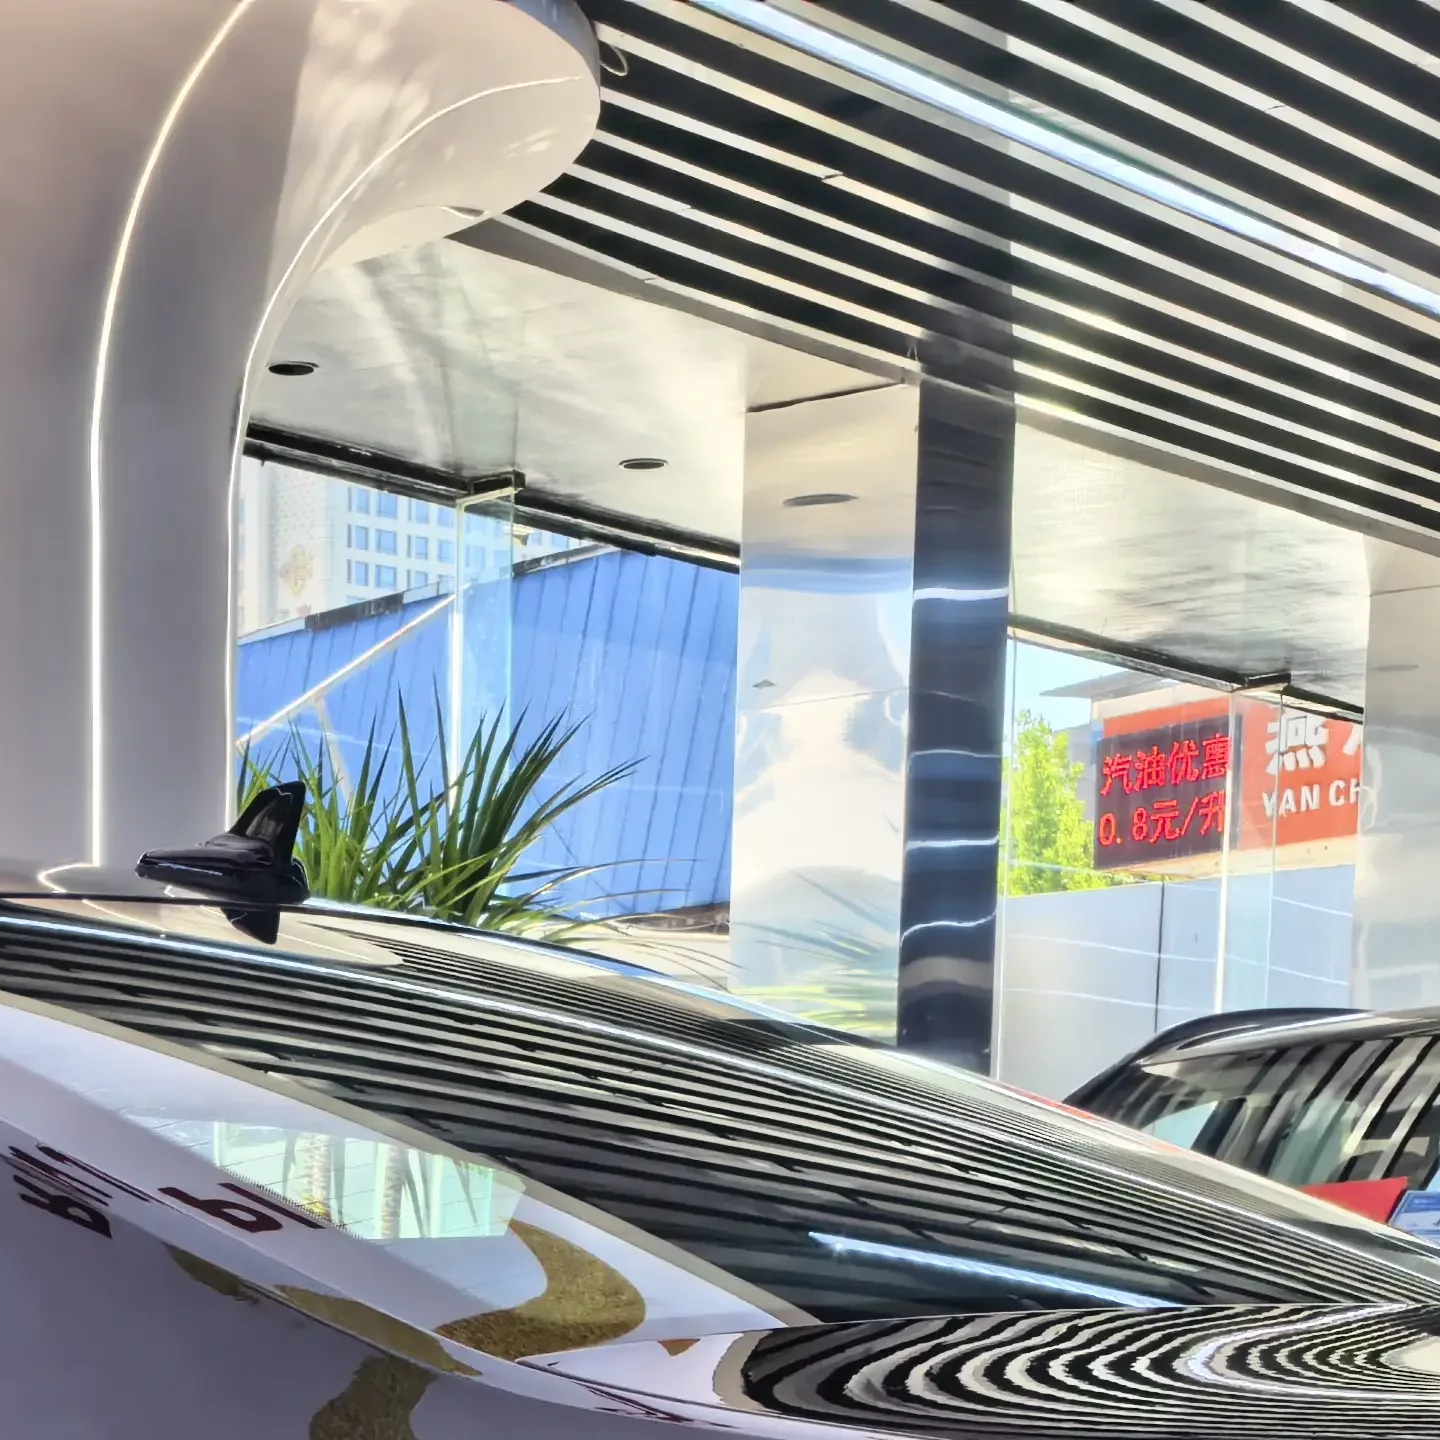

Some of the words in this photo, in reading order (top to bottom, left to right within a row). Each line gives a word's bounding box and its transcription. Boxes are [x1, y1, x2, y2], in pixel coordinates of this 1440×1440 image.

[1100, 733, 1230, 796] 汽油优惠
[1262, 785, 1320, 818] YAN
